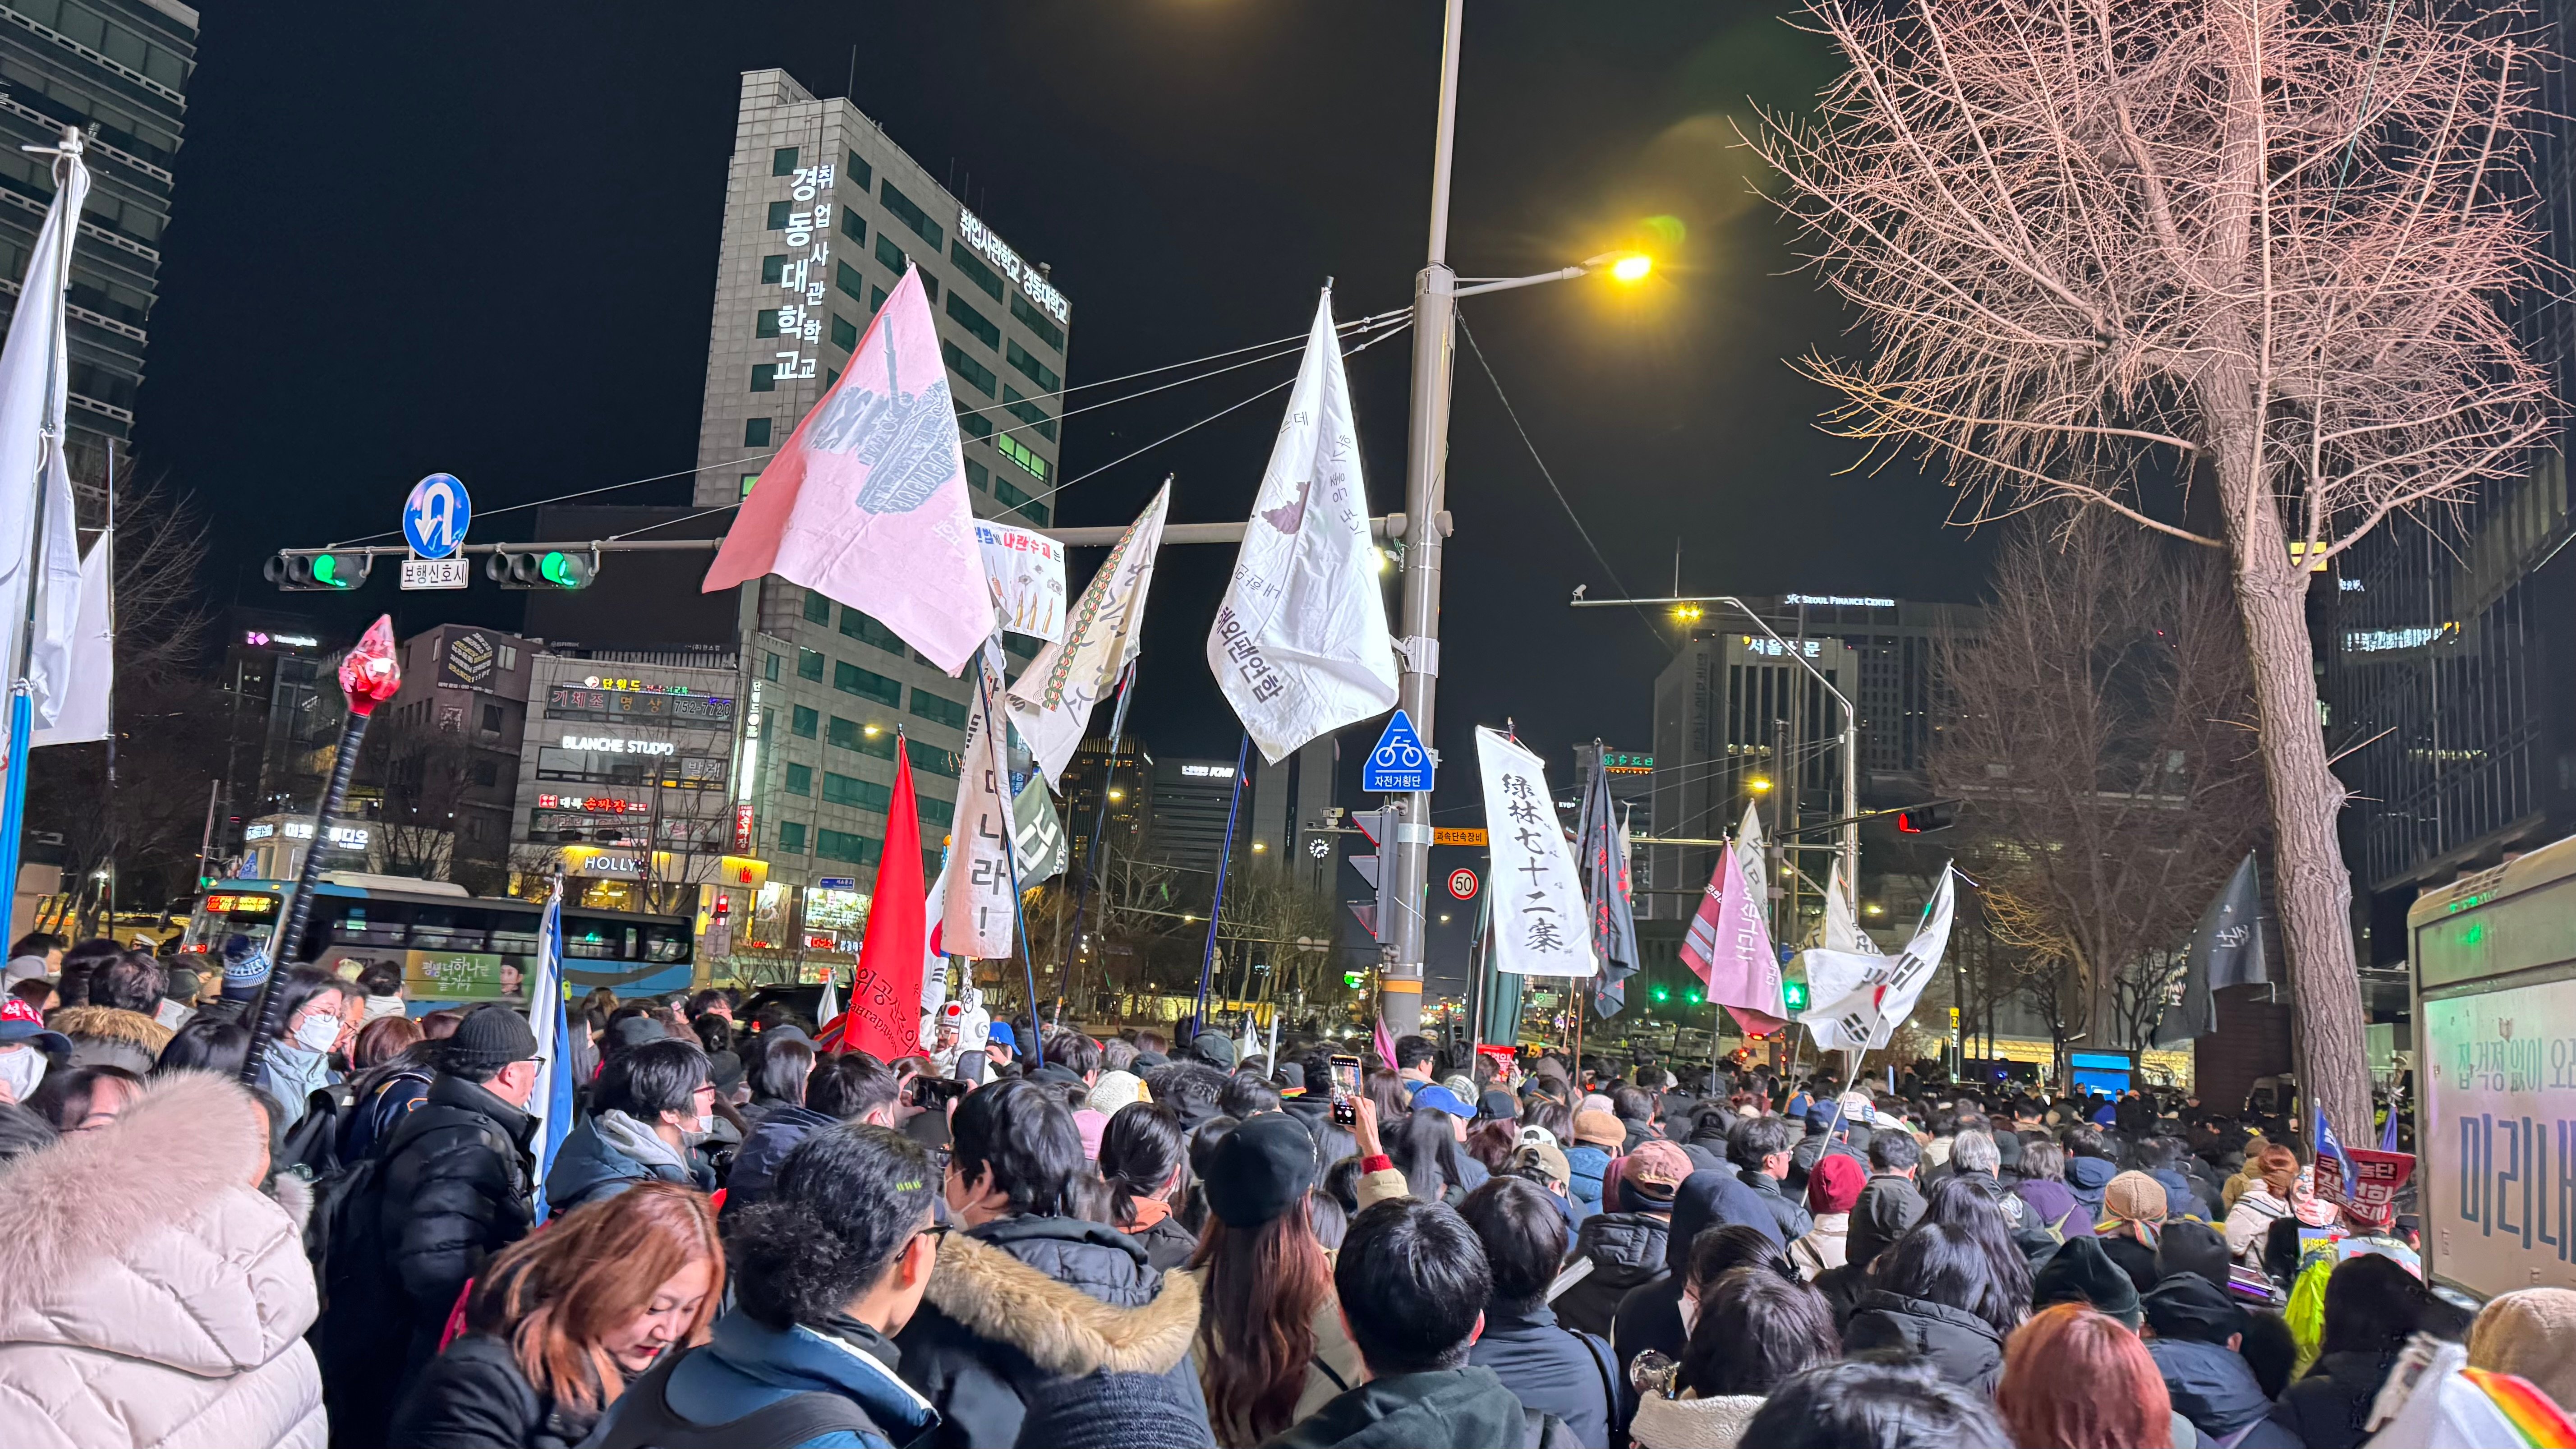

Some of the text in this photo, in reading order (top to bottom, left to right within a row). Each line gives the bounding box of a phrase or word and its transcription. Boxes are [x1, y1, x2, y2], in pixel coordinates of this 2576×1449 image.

[773, 166, 818, 380] 경동대학교
[798, 164, 835, 379] 취업사관학교
[959, 207, 1068, 324] 취업사관학교 경동대학교
[405, 563, 465, 584] 보행신호시
[1802, 595, 1829, 605] SEOUL
[1830, 596, 1865, 606] FINANCE
[1864, 597, 1895, 607] CENTER
[1216, 606, 1284, 704] 해외팬연합
[603, 677, 641, 691] 단월드
[552, 690, 604, 708] 기체조
[674, 700, 731, 718] 752-7720
[562, 736, 675, 756] BLANCHE STUDIO
[688, 761, 721, 778] 발레
[1374, 775, 1421, 787] 자전거횡단
[1455, 876, 1472, 892] 50
[2457, 1041, 2471, 1090] 집
[2475, 1040, 2505, 1093] 걱정
[2510, 1037, 2543, 1096] 없이
